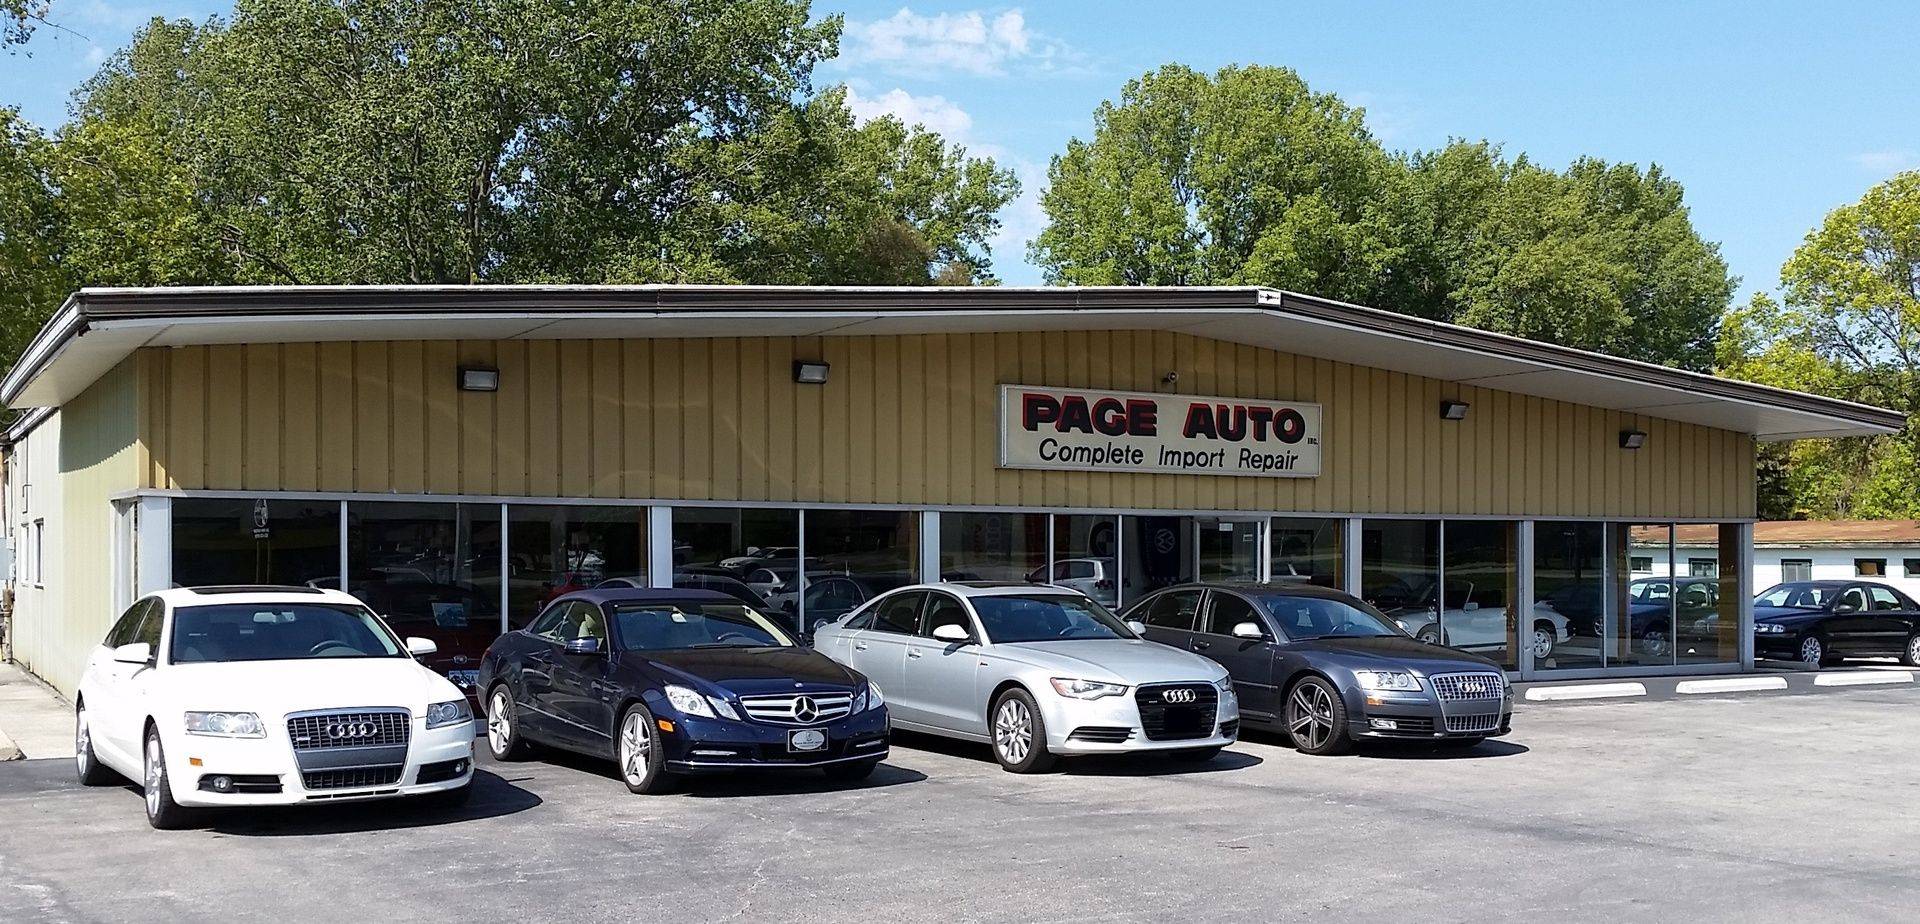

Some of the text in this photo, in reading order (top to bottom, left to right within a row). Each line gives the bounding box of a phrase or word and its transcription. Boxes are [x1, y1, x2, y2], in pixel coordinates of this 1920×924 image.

[1023, 393, 1158, 437] PAGE
[1182, 403, 1306, 444] AUTO
[1039, 438, 1299, 472] Complete Import Repair
